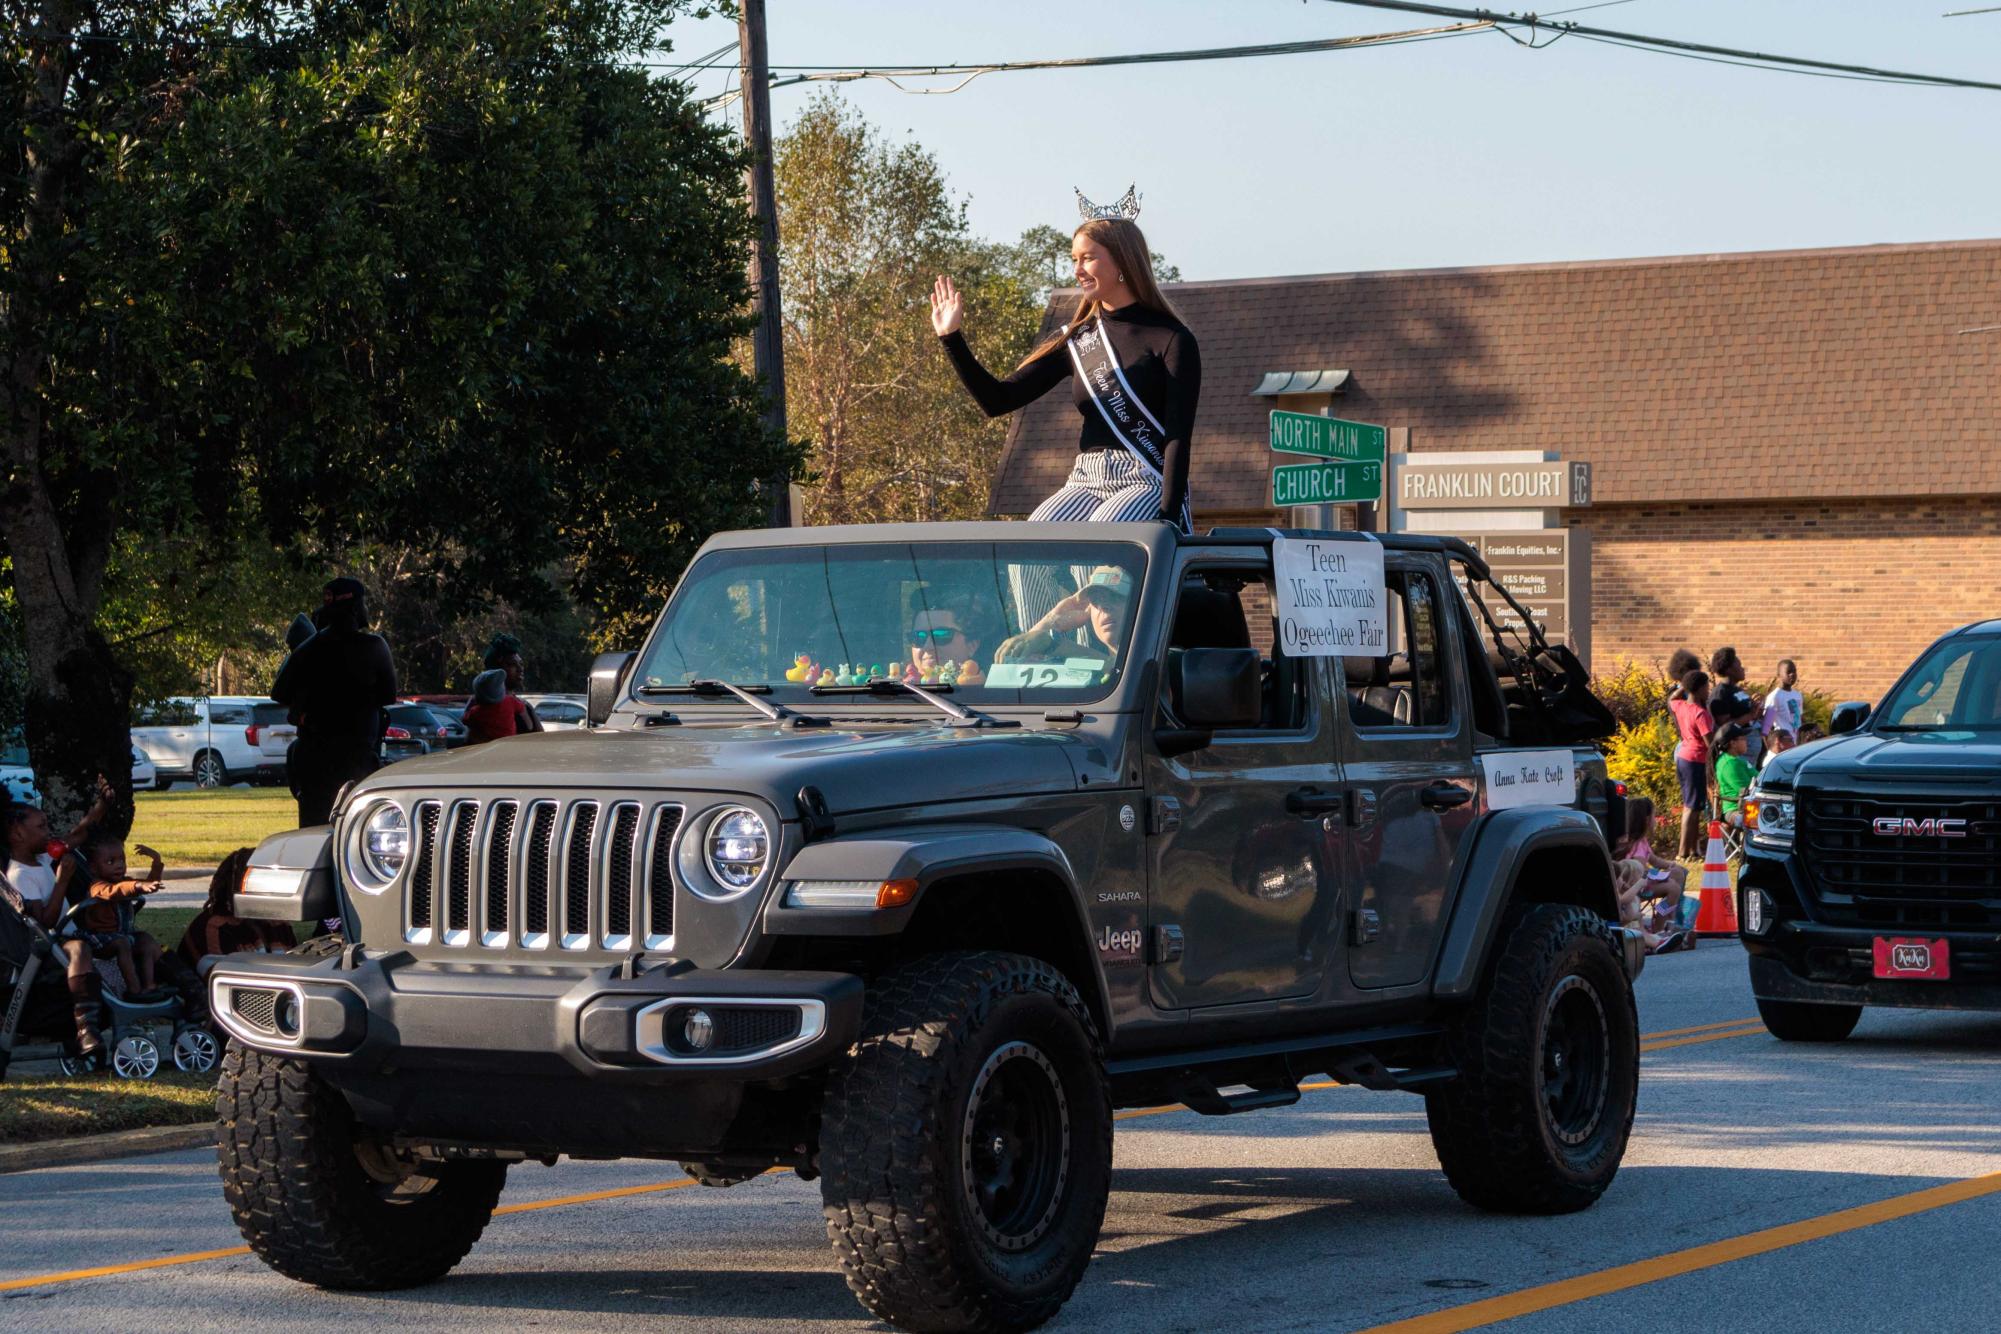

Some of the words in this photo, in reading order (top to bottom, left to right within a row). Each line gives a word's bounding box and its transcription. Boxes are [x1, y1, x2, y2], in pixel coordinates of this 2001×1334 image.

[1093, 361, 1110, 392] Teen
[1107, 390, 1130, 423] Miss
[1273, 416, 1321, 450] NORTH
[1328, 423, 1359, 456] MAIN
[1372, 430, 1383, 446] ST
[1276, 467, 1346, 501] CHURCH
[1362, 465, 1379, 481] ST
[1403, 472, 1493, 498] FRANKLIN
[1499, 471, 1563, 497] COURT
[1305, 543, 1348, 573] Teen
[1487, 545, 1516, 555] Franklin
[1289, 577, 1323, 609] Miss
[1324, 577, 1377, 609] Kiwanis
[1503, 574, 1518, 584] R&S
[1519, 574, 1546, 585] Packing
[1509, 585, 1533, 595] Moving
[1534, 584, 1547, 594] LLC
[1283, 616, 1355, 654] Ogeechee
[1357, 618, 1384, 648] Fair
[1019, 667, 1059, 688] 12
[1494, 770, 1516, 788] Anna
[1520, 766, 1539, 785] Kate
[1544, 765, 1564, 788] Croft
[1872, 817, 1967, 838] GMC
[1098, 891, 1142, 902] SAHARA
[1098, 925, 1143, 954] Jeep
